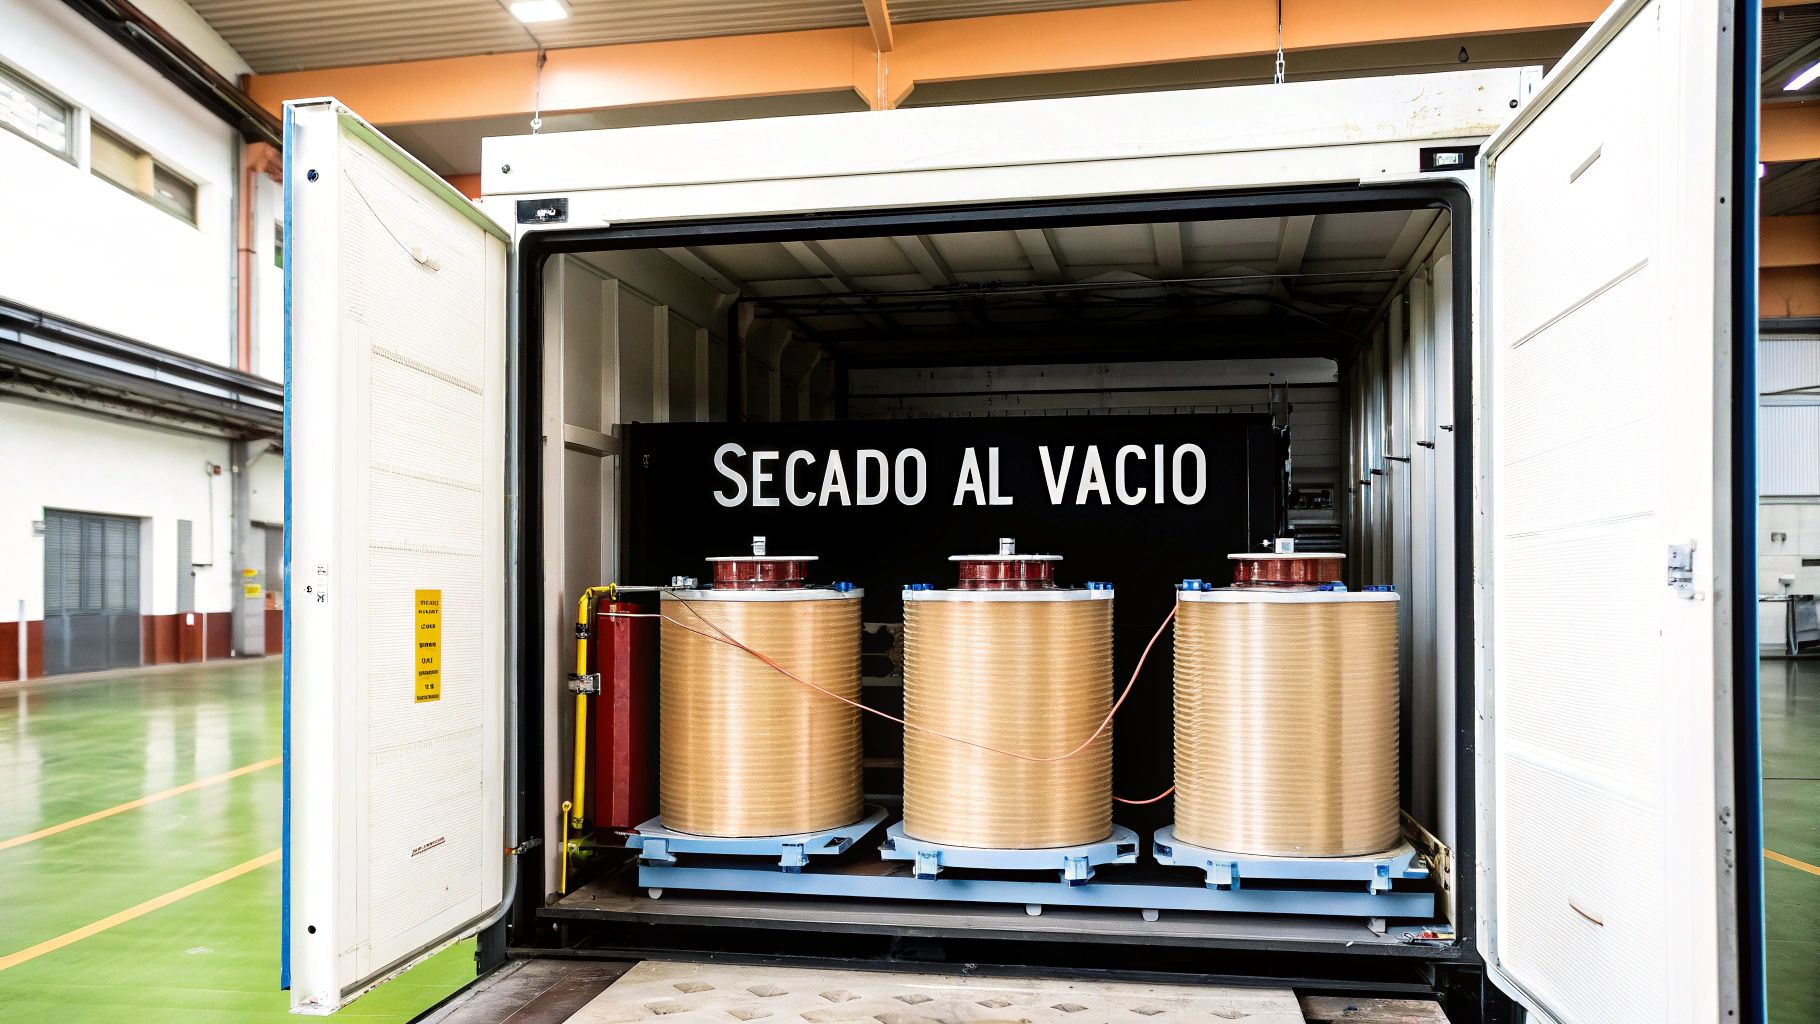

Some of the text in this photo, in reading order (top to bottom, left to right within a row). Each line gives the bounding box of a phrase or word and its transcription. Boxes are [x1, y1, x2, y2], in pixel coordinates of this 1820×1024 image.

[713, 442, 1208, 508] SECADO AL VACIO
